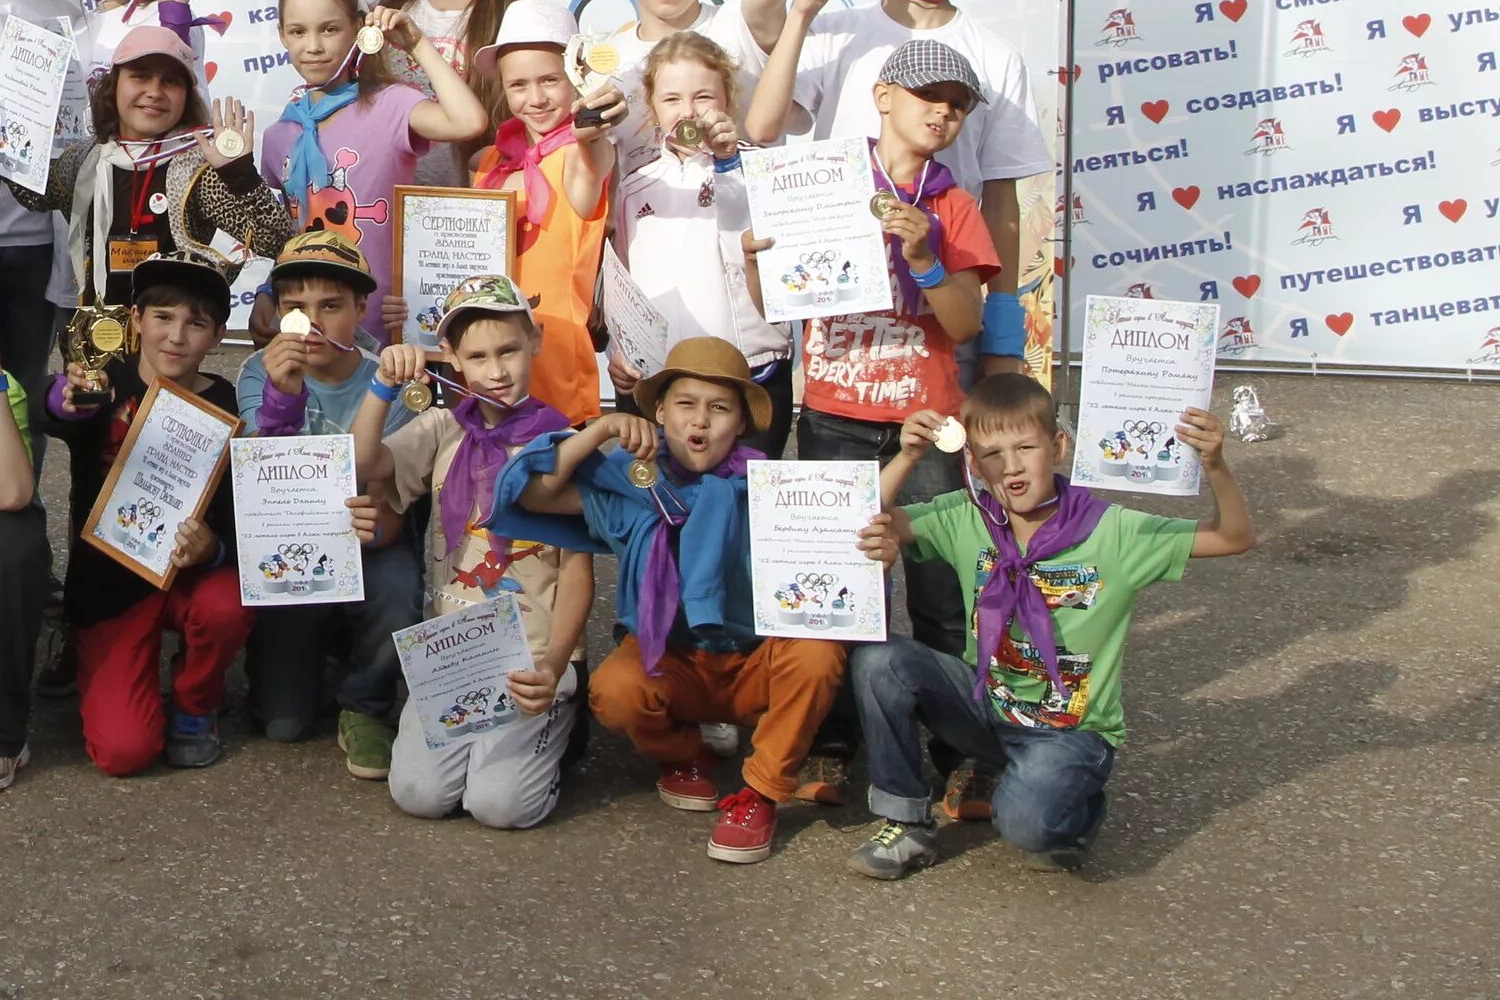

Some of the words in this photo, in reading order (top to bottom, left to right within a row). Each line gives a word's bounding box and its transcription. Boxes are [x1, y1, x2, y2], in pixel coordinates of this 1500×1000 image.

[1195, 3, 1214, 23] Я
[1366, 20, 1386, 39] Я
[10, 45, 52, 71] ДИПЛОМ
[1098, 41, 1238, 81] рисовать!
[1477, 52, 1496, 72] Я
[1106, 106, 1125, 125] Я
[1186, 73, 1343, 114] создавать!
[1337, 115, 1356, 135] Я
[772, 167, 844, 194] ДИПЛОМ
[1137, 191, 1155, 211] Я
[1218, 151, 1437, 200] наслаждаться!
[422, 216, 491, 232] СЕРТИФИКАТ
[1402, 205, 1422, 225] Я
[1092, 232, 1233, 269] сочинять!
[1199, 281, 1218, 299] Я
[1280, 244, 1500, 291] путешествоват
[1111, 329, 1190, 350] ДИПЛОМ
[1289, 318, 1308, 337] Я
[807, 356, 863, 387] EVERY
[856, 377, 916, 404] TIME!
[161, 415, 213, 453] СЕРТИФИКАТ
[257, 464, 328, 484] ДИПЛОМ
[775, 491, 851, 508] ДИПЛОМ
[425, 622, 496, 659] ДИПЛОМ
